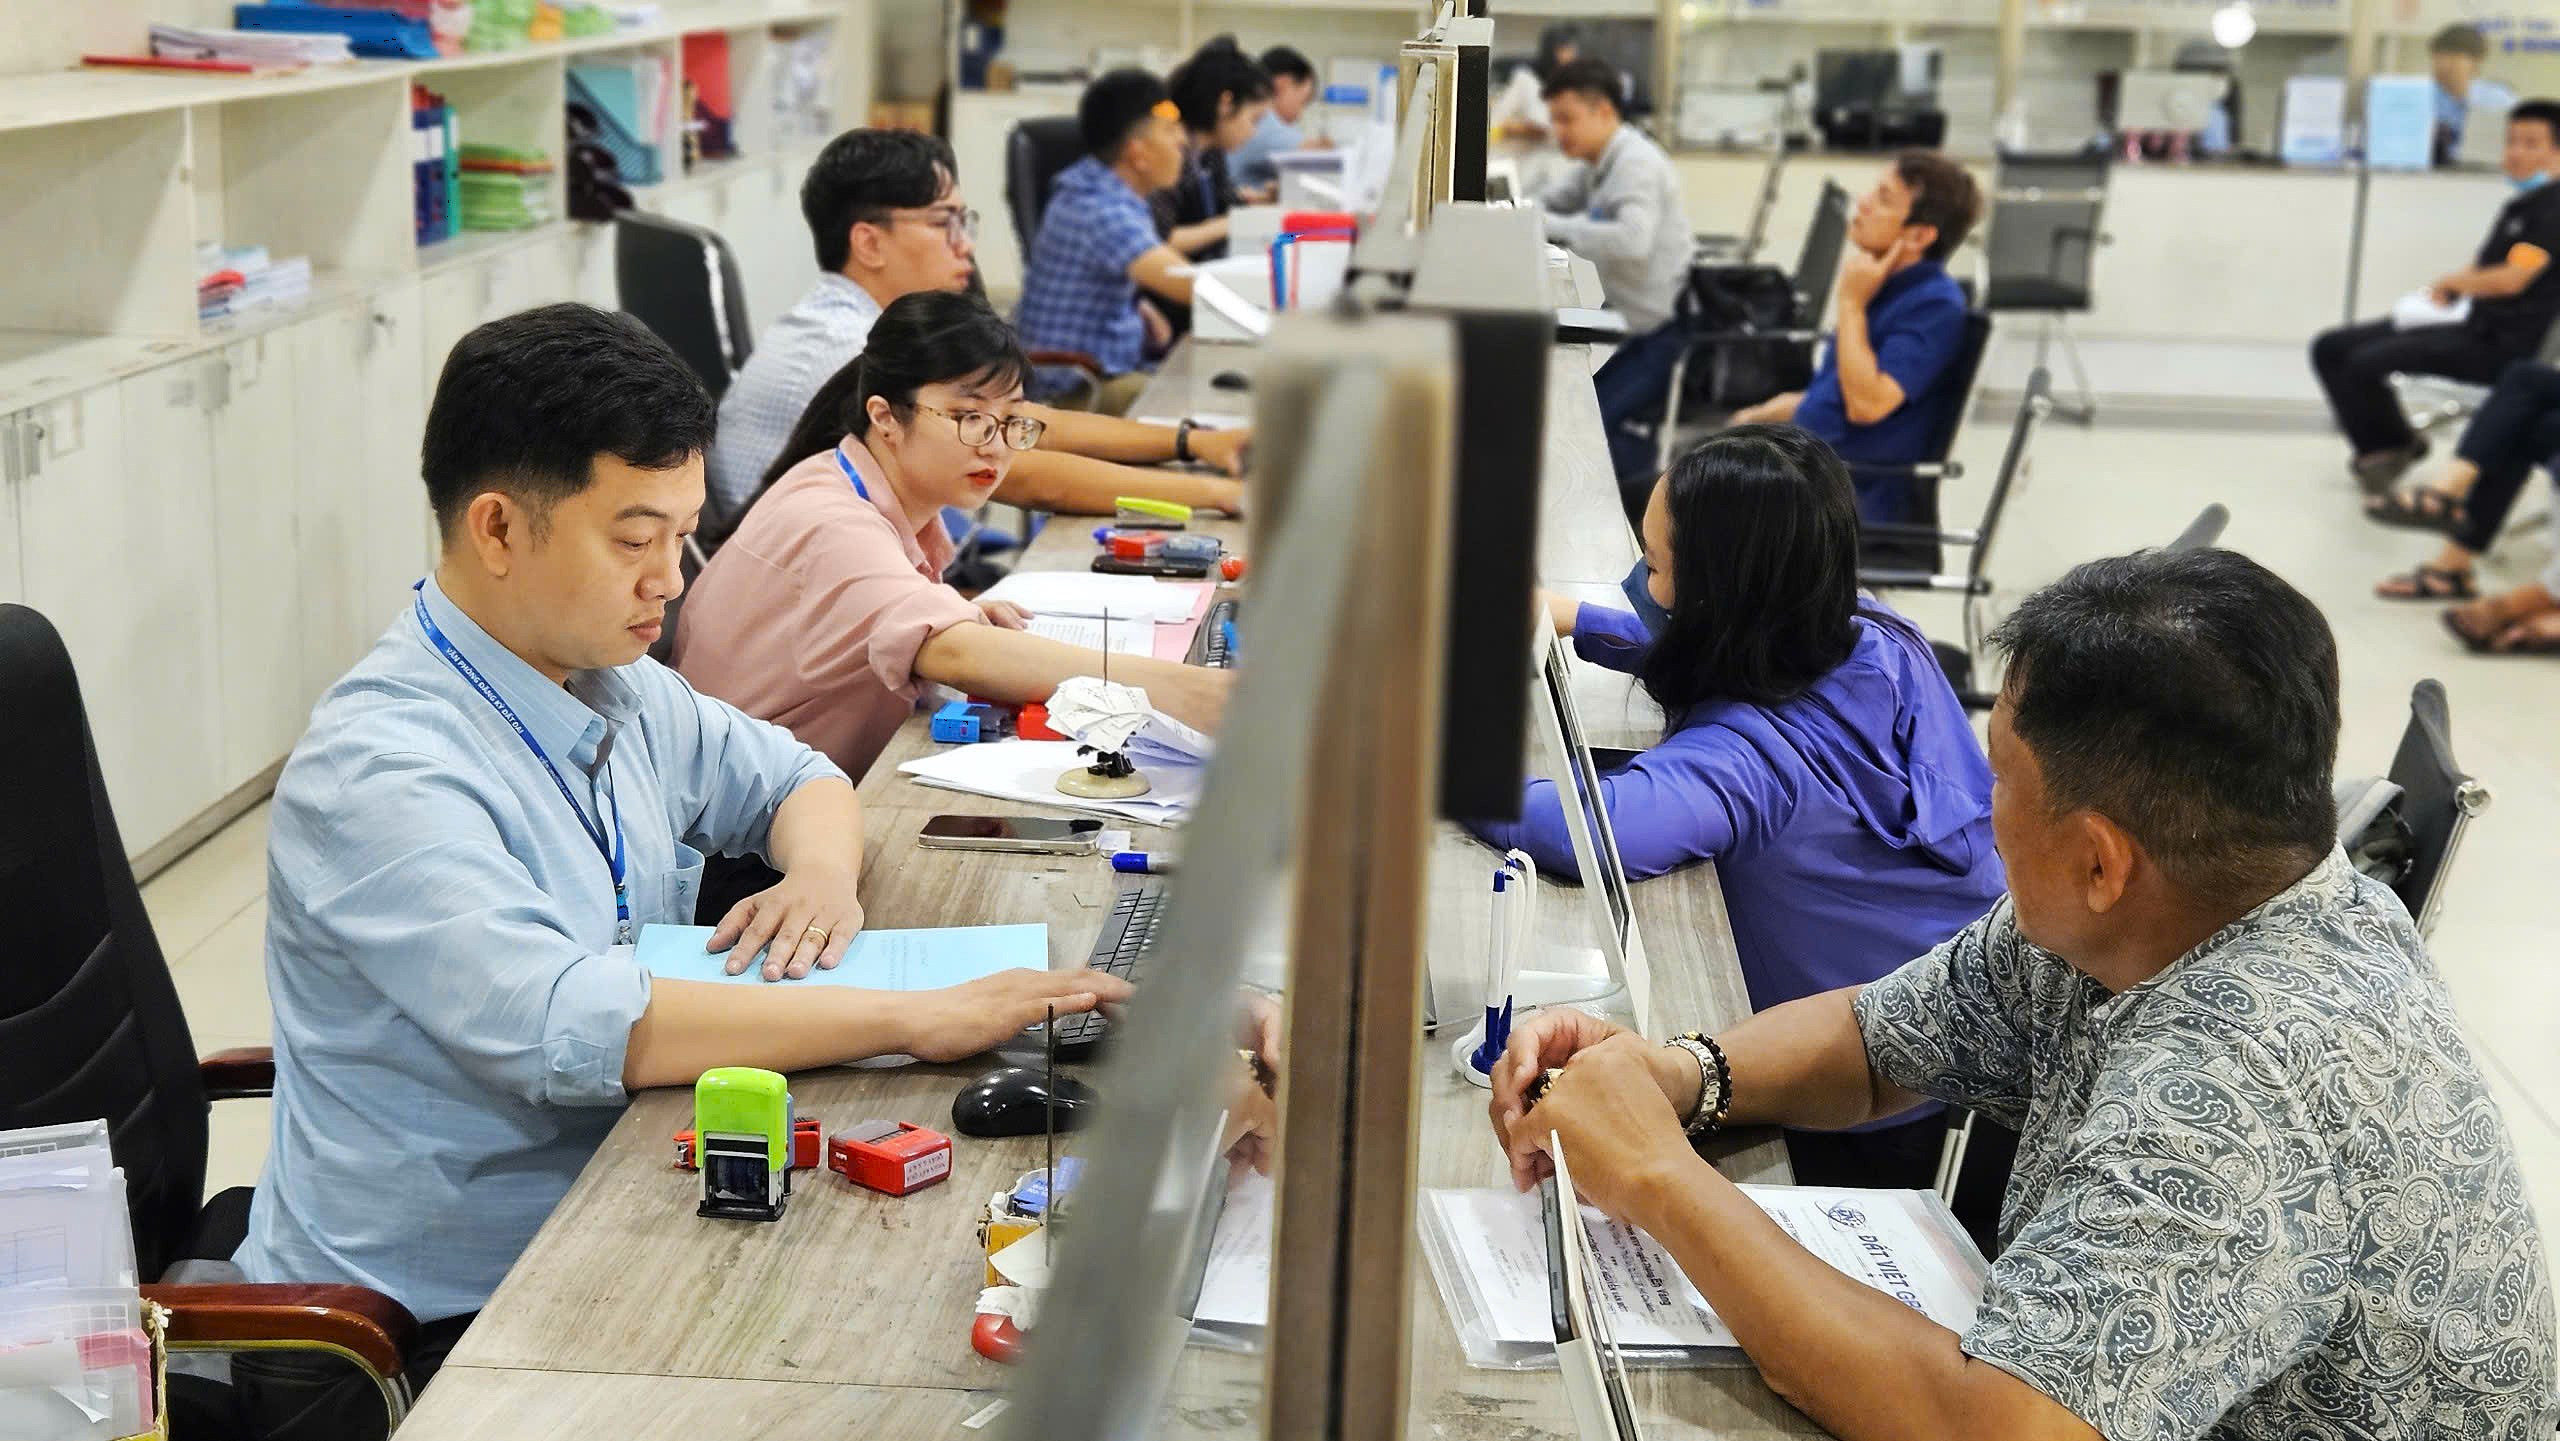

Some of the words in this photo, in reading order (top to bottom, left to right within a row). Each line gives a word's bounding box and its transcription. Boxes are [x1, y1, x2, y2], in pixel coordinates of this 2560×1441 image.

[446, 647, 460, 663] VĂN
[458, 660, 480, 684] PHÒNG
[478, 681, 497, 702] ĐĂNG
[494, 700, 505, 712] KÝ
[1858, 1234, 1893, 1258] ĐẤT
[1876, 1260, 1909, 1288] VIỆT
